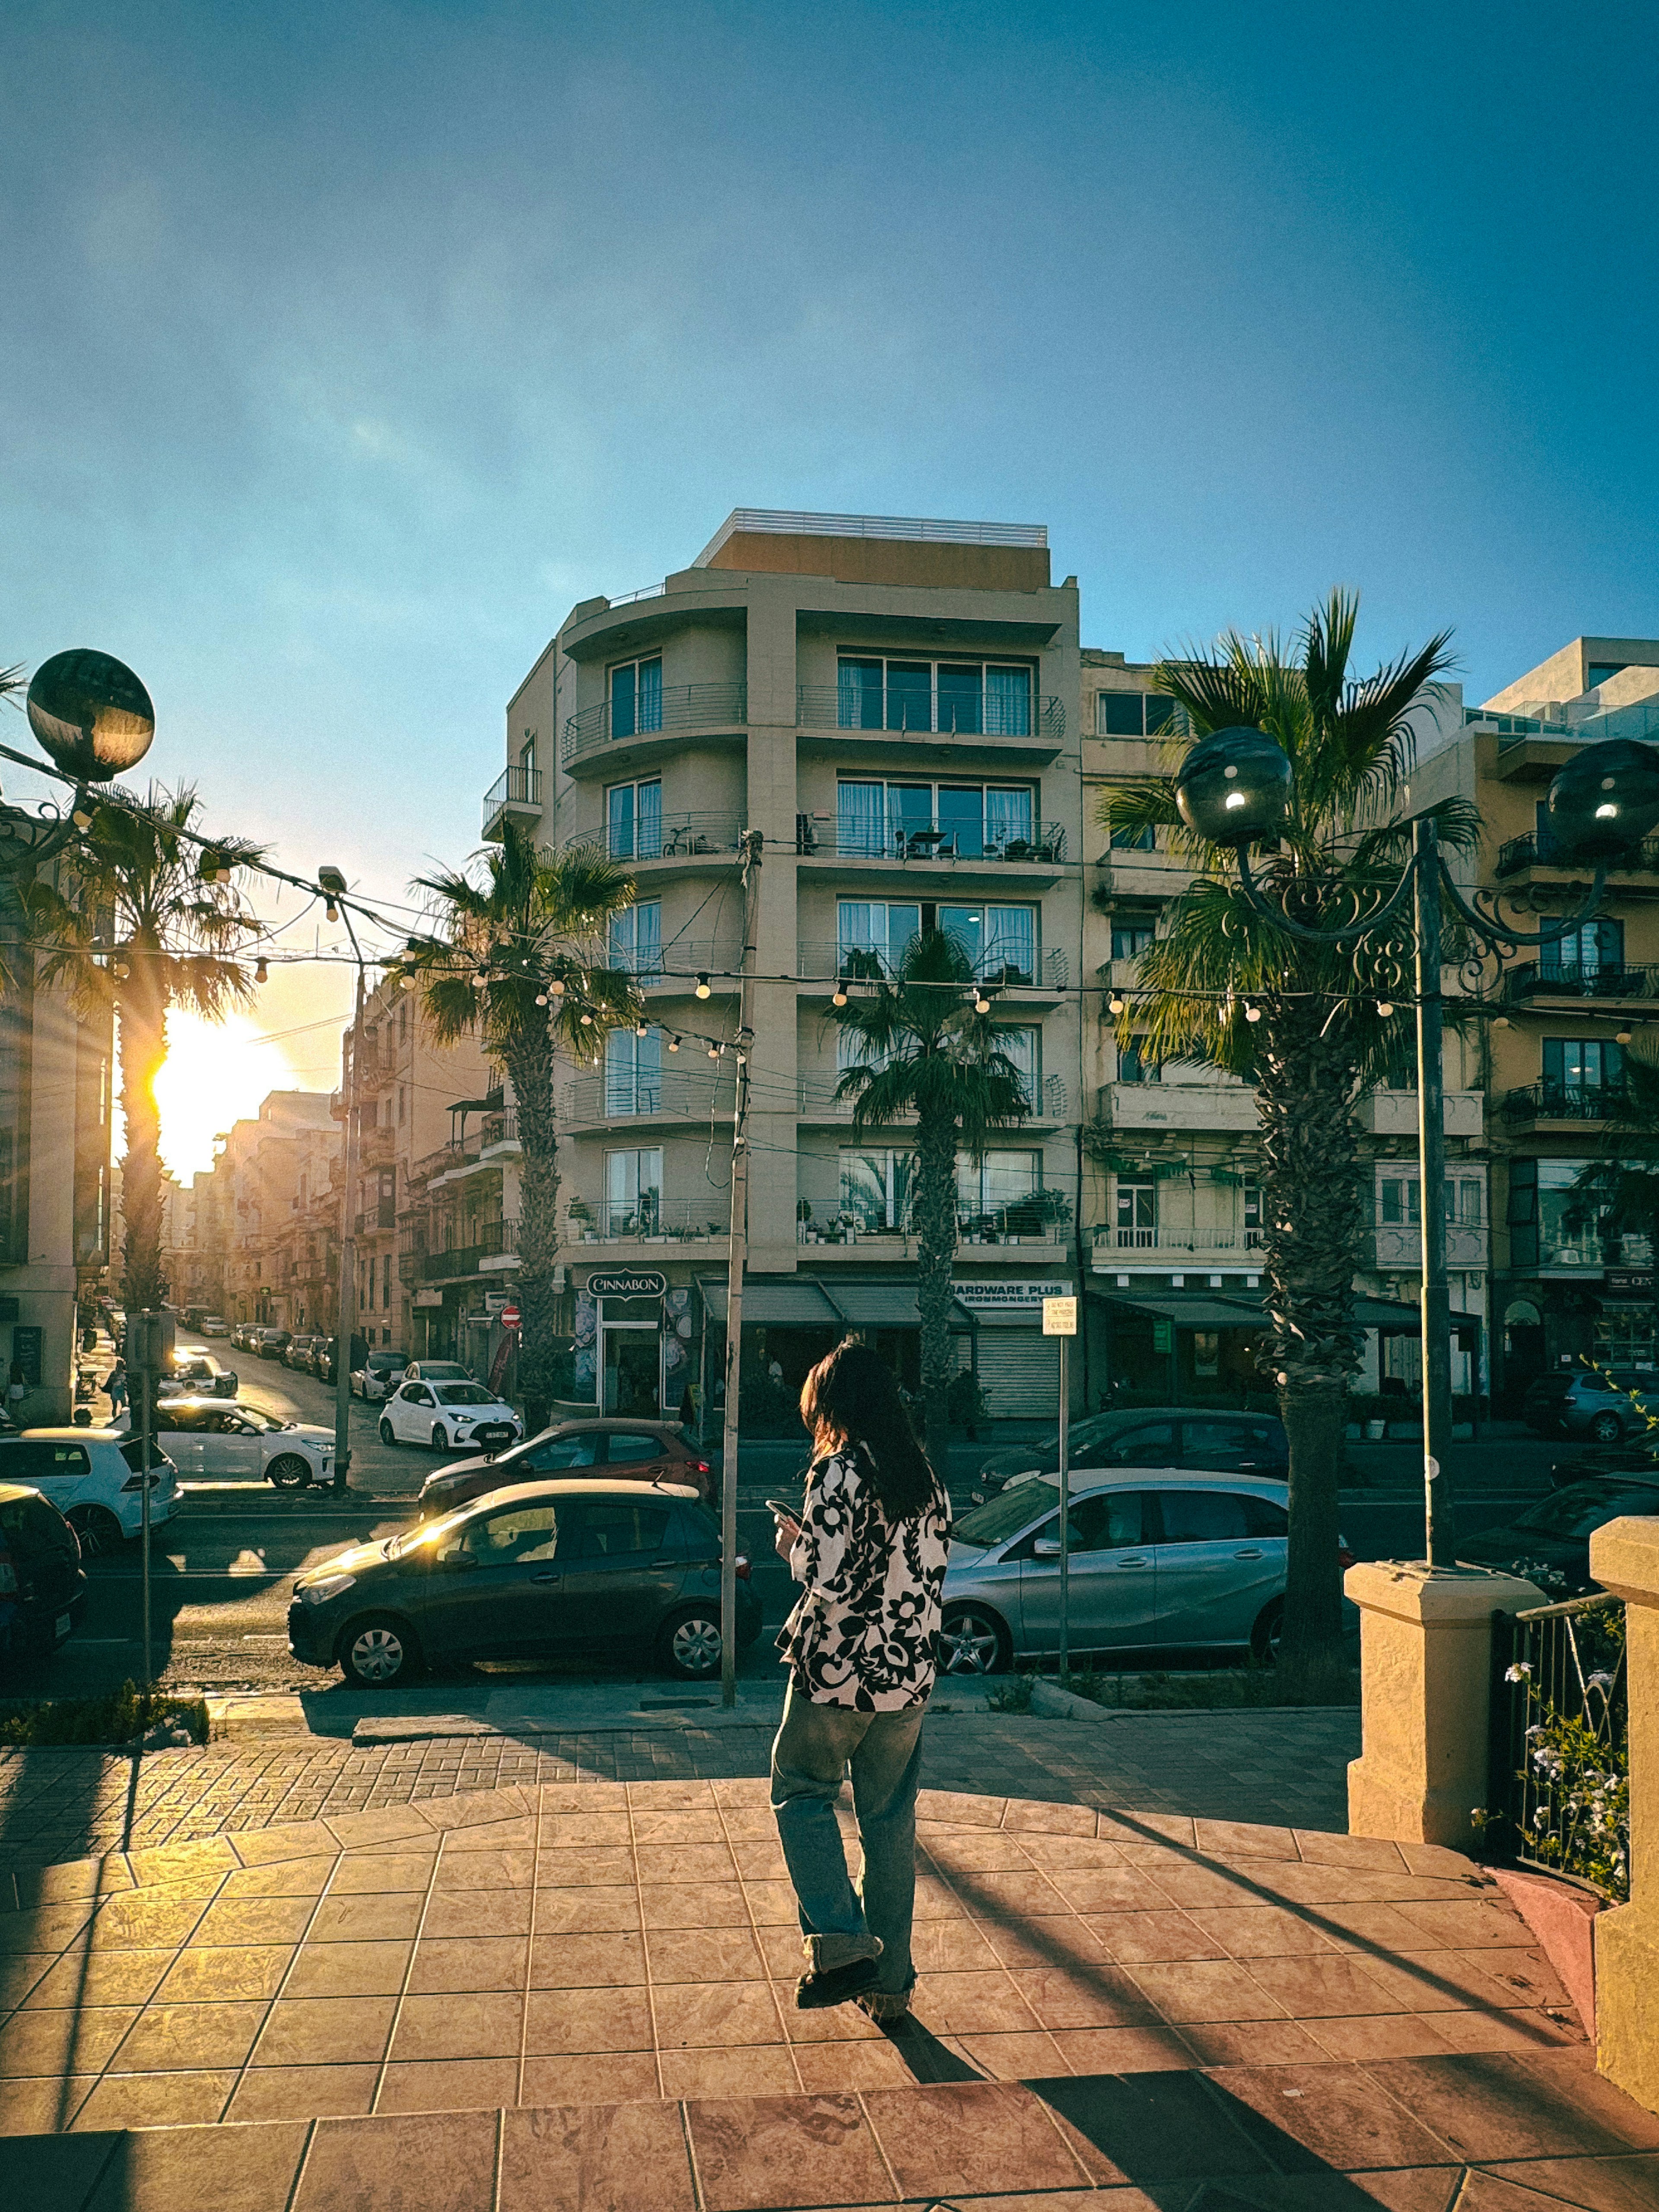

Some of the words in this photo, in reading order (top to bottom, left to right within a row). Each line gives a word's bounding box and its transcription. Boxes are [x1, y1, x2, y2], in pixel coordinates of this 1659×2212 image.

[593, 1278, 659, 1292] CINNABON
[952, 1285, 1023, 1295] ARDWARE
[1029, 1286, 1062, 1295] PLUS
